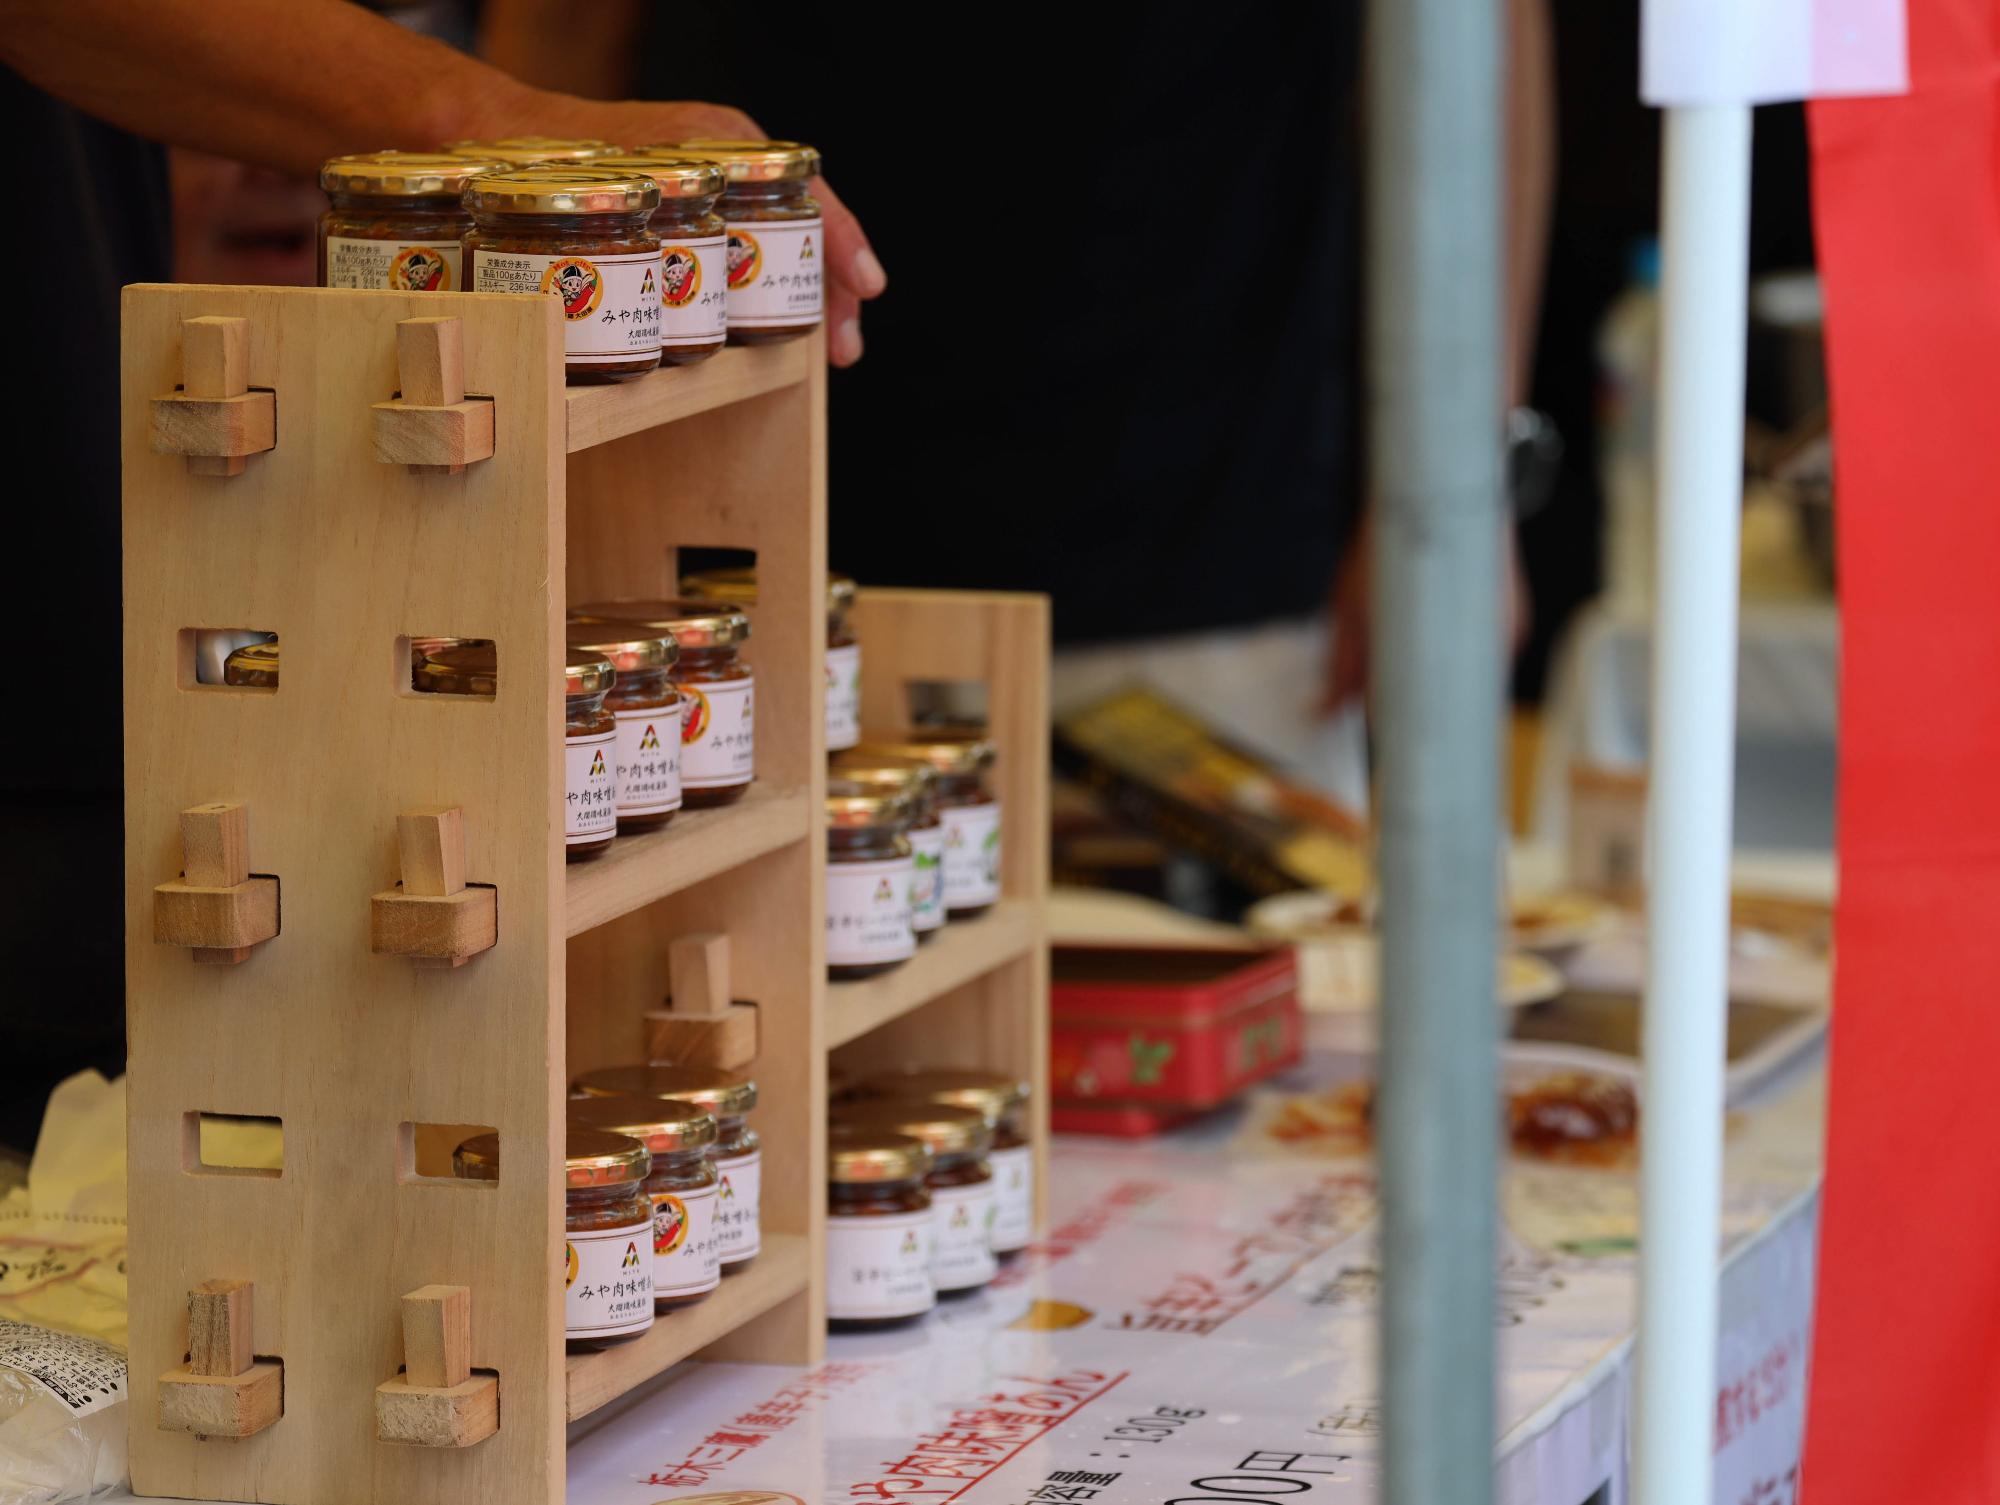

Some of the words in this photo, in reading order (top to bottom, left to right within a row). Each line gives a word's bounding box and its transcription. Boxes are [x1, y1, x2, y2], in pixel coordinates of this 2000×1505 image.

[487, 258, 531, 270] 栄養成分表示
[483, 269, 537, 281] 製品100gあたり
[850, 1370, 1106, 1505] や肉味噌あん
